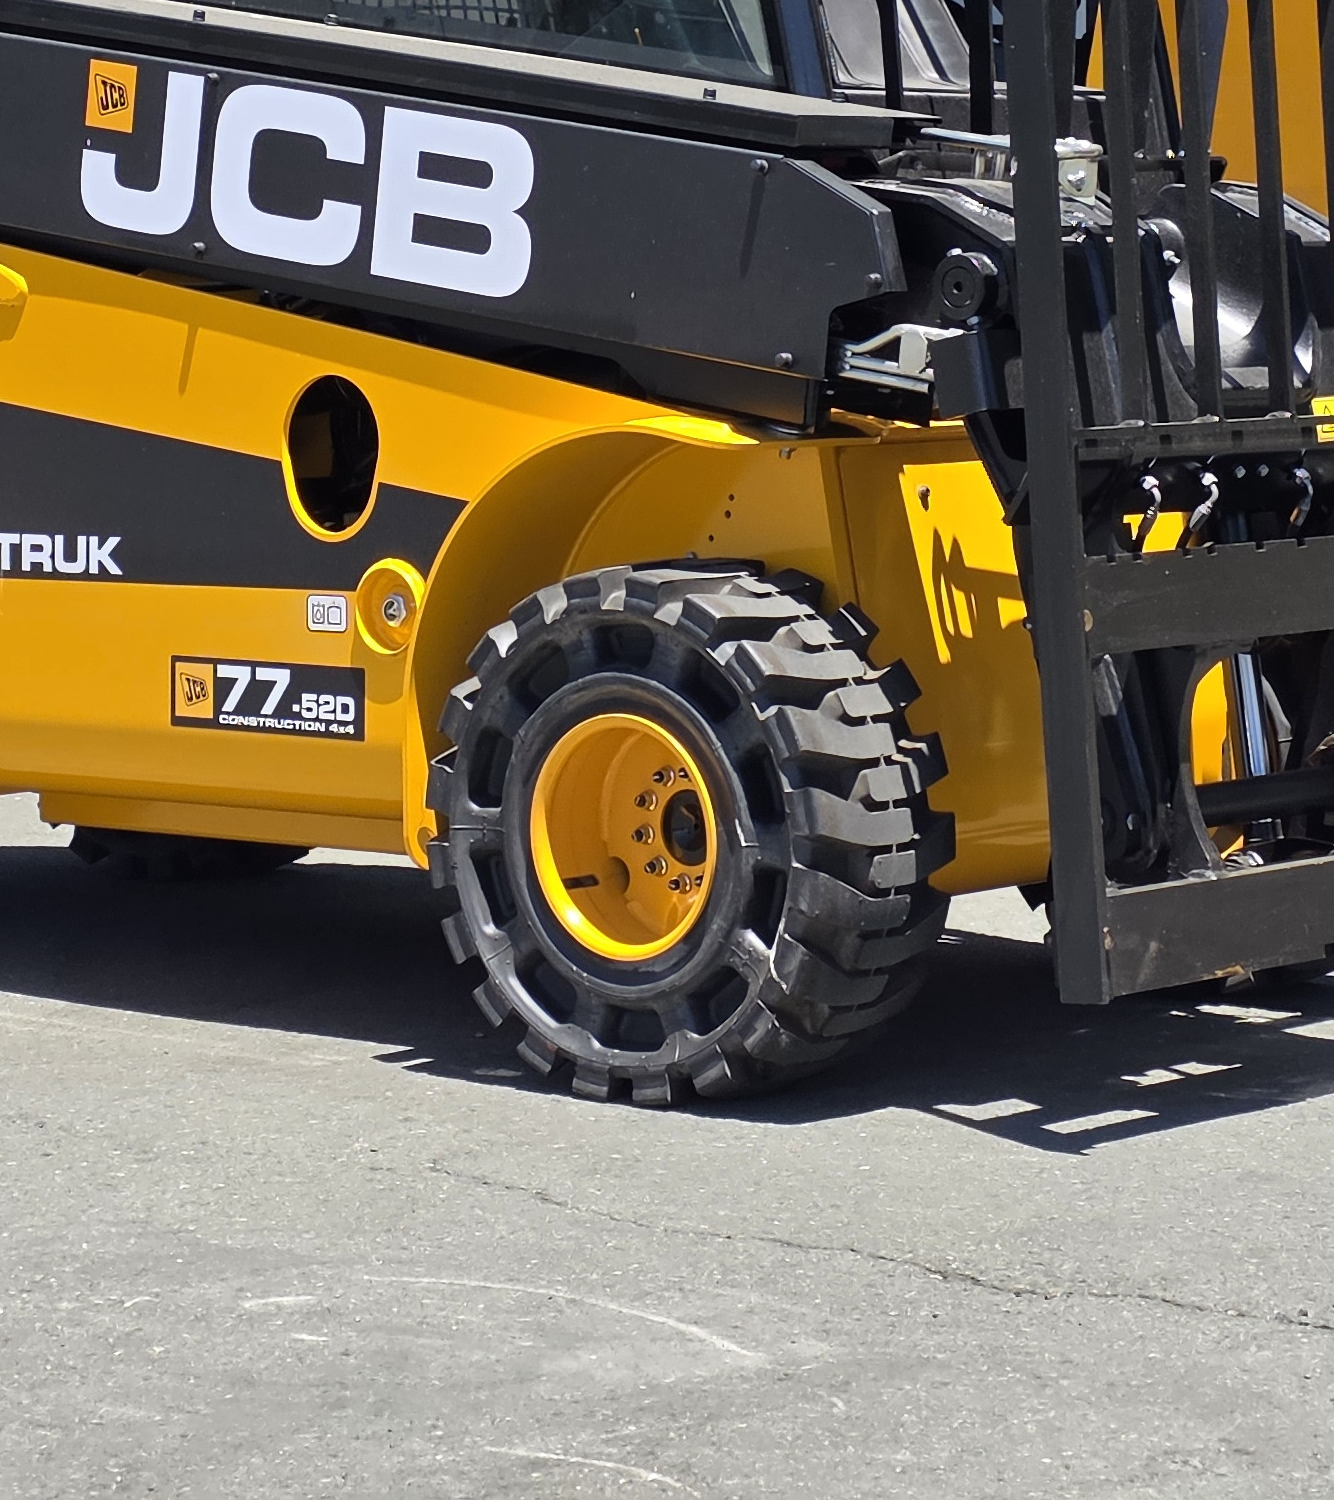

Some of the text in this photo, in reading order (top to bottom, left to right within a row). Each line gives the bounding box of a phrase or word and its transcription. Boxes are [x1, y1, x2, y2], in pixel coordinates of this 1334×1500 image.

[100, 80, 126, 111] JCB
[81, 70, 535, 298] JCB
[185, 677, 207, 703] JCB
[219, 714, 355, 735] CONSTRUCTION 4x4
